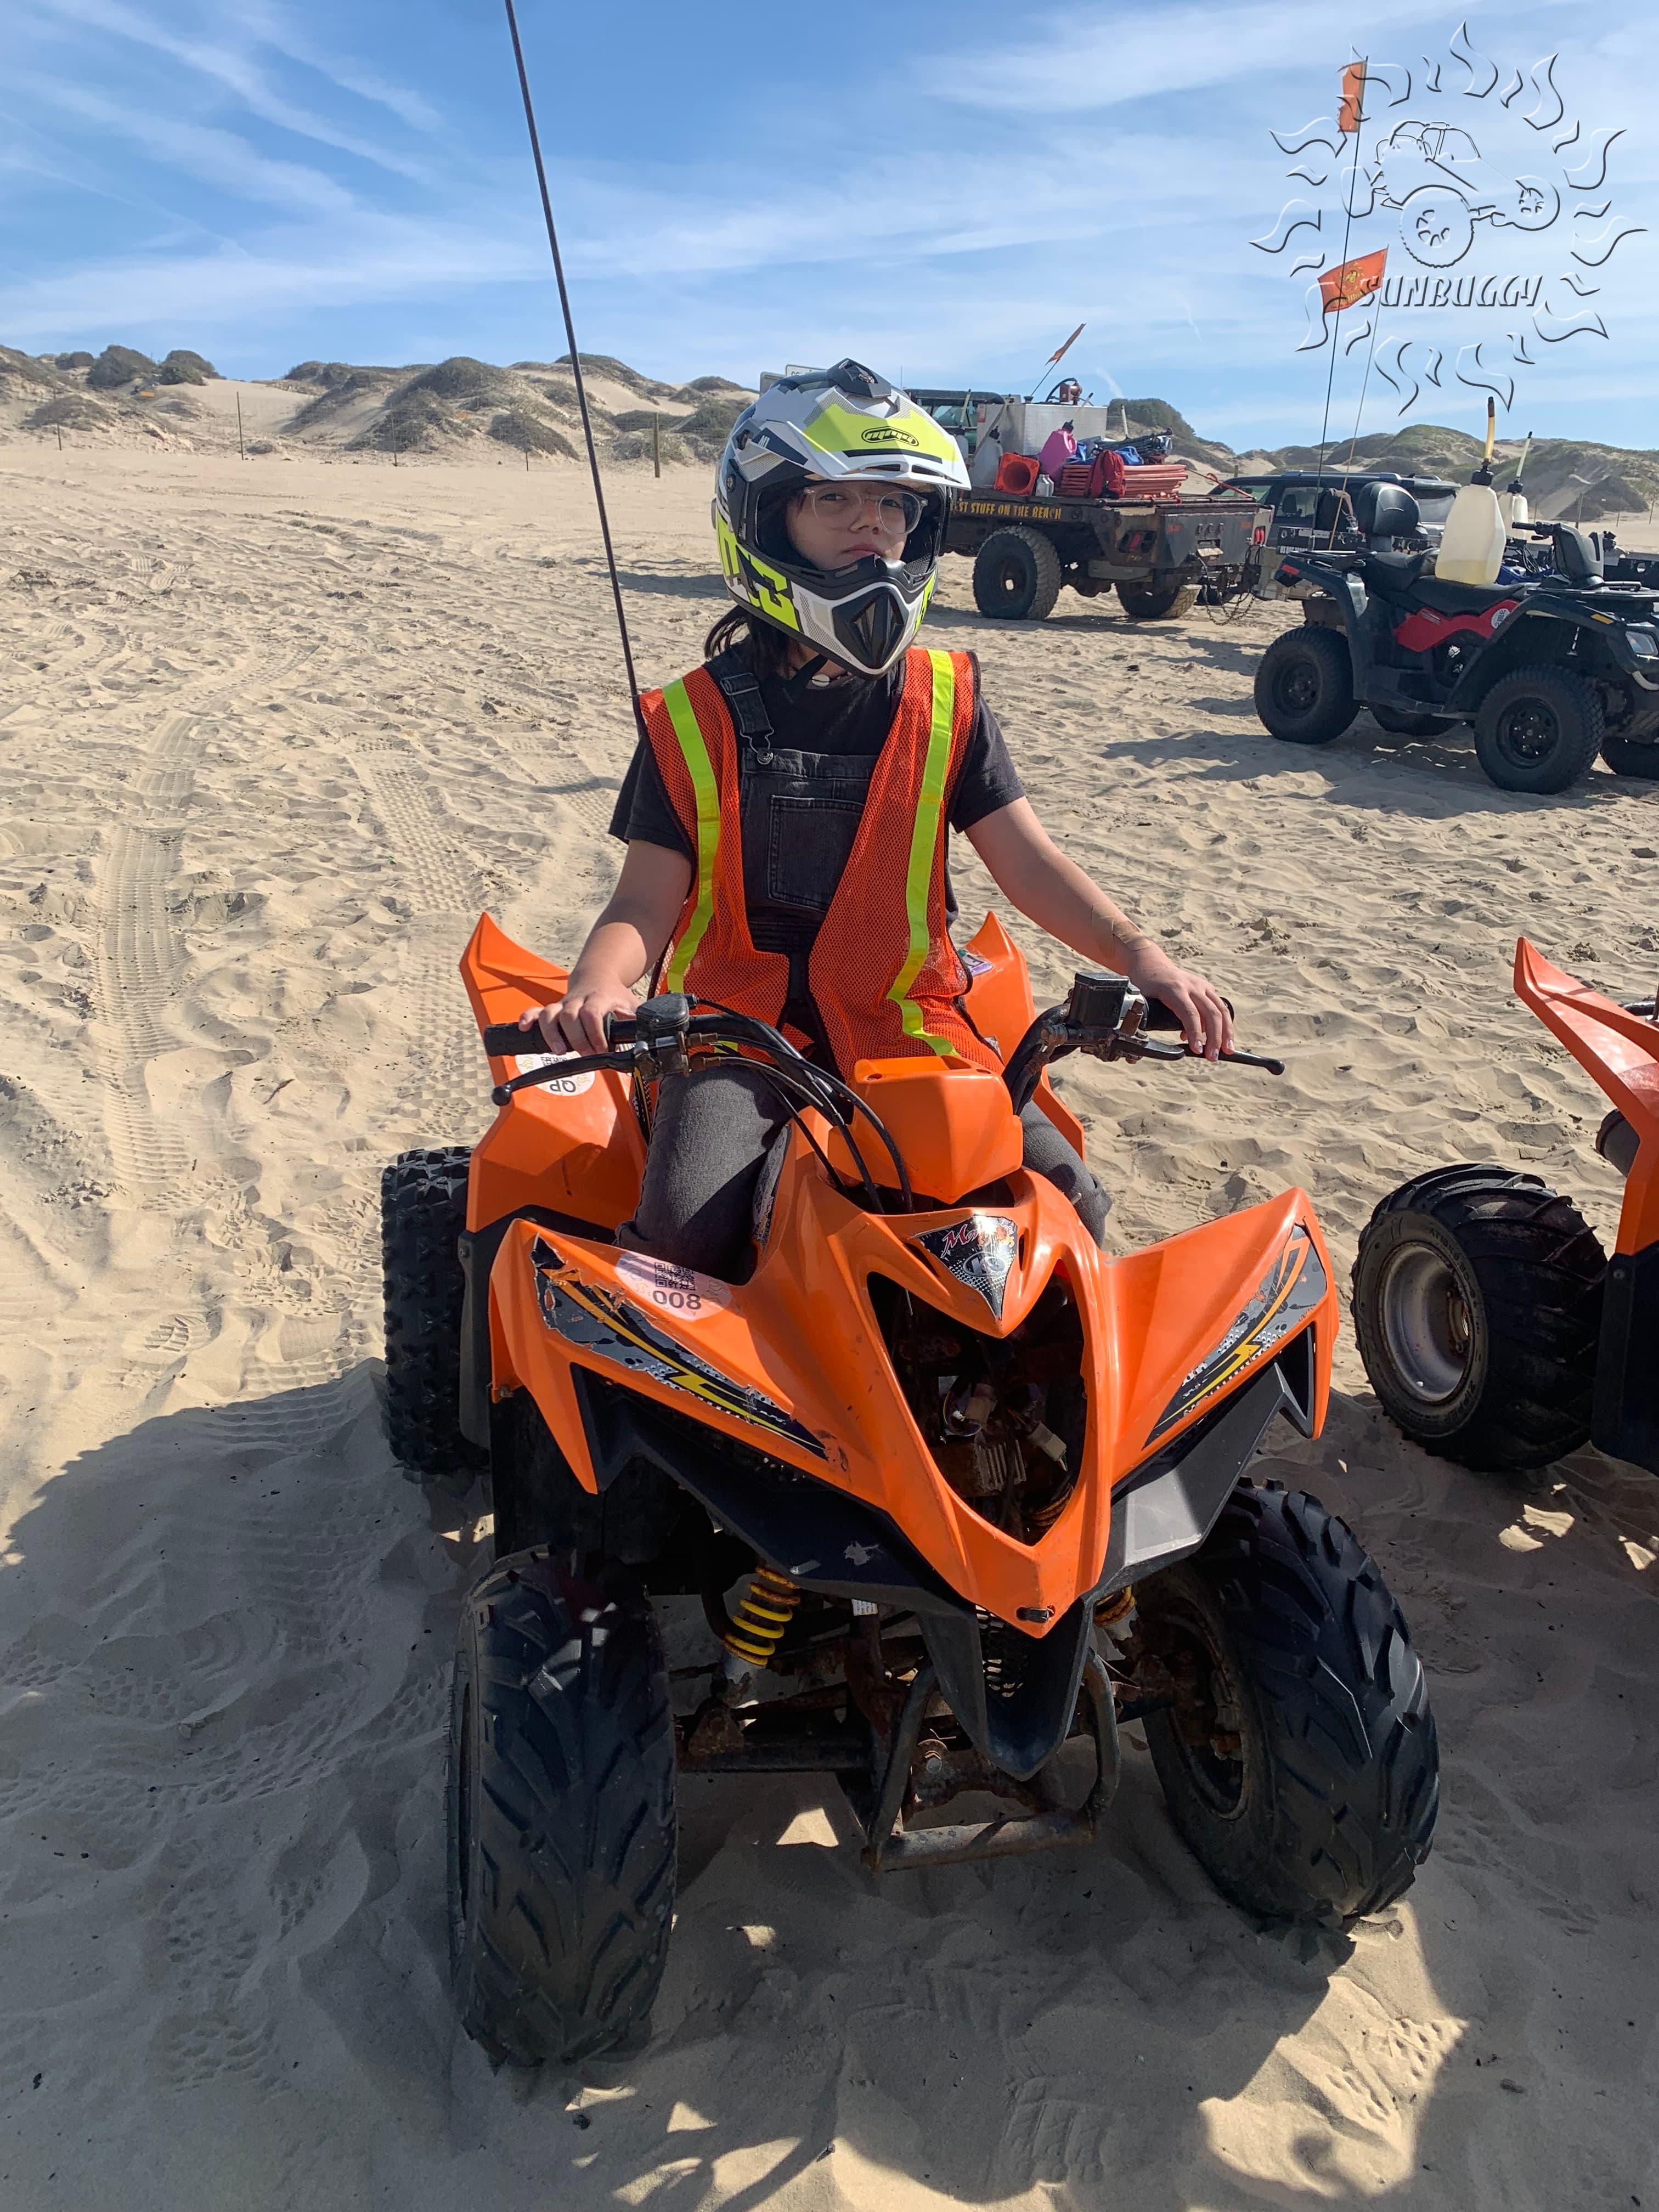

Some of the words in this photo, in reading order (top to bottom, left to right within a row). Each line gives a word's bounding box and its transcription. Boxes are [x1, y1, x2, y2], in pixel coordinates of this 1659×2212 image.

[970, 501, 996, 515] STUFF
[997, 504, 1010, 516] ON
[1013, 505, 1030, 517] THE
[652, 1290, 702, 1310] 008
